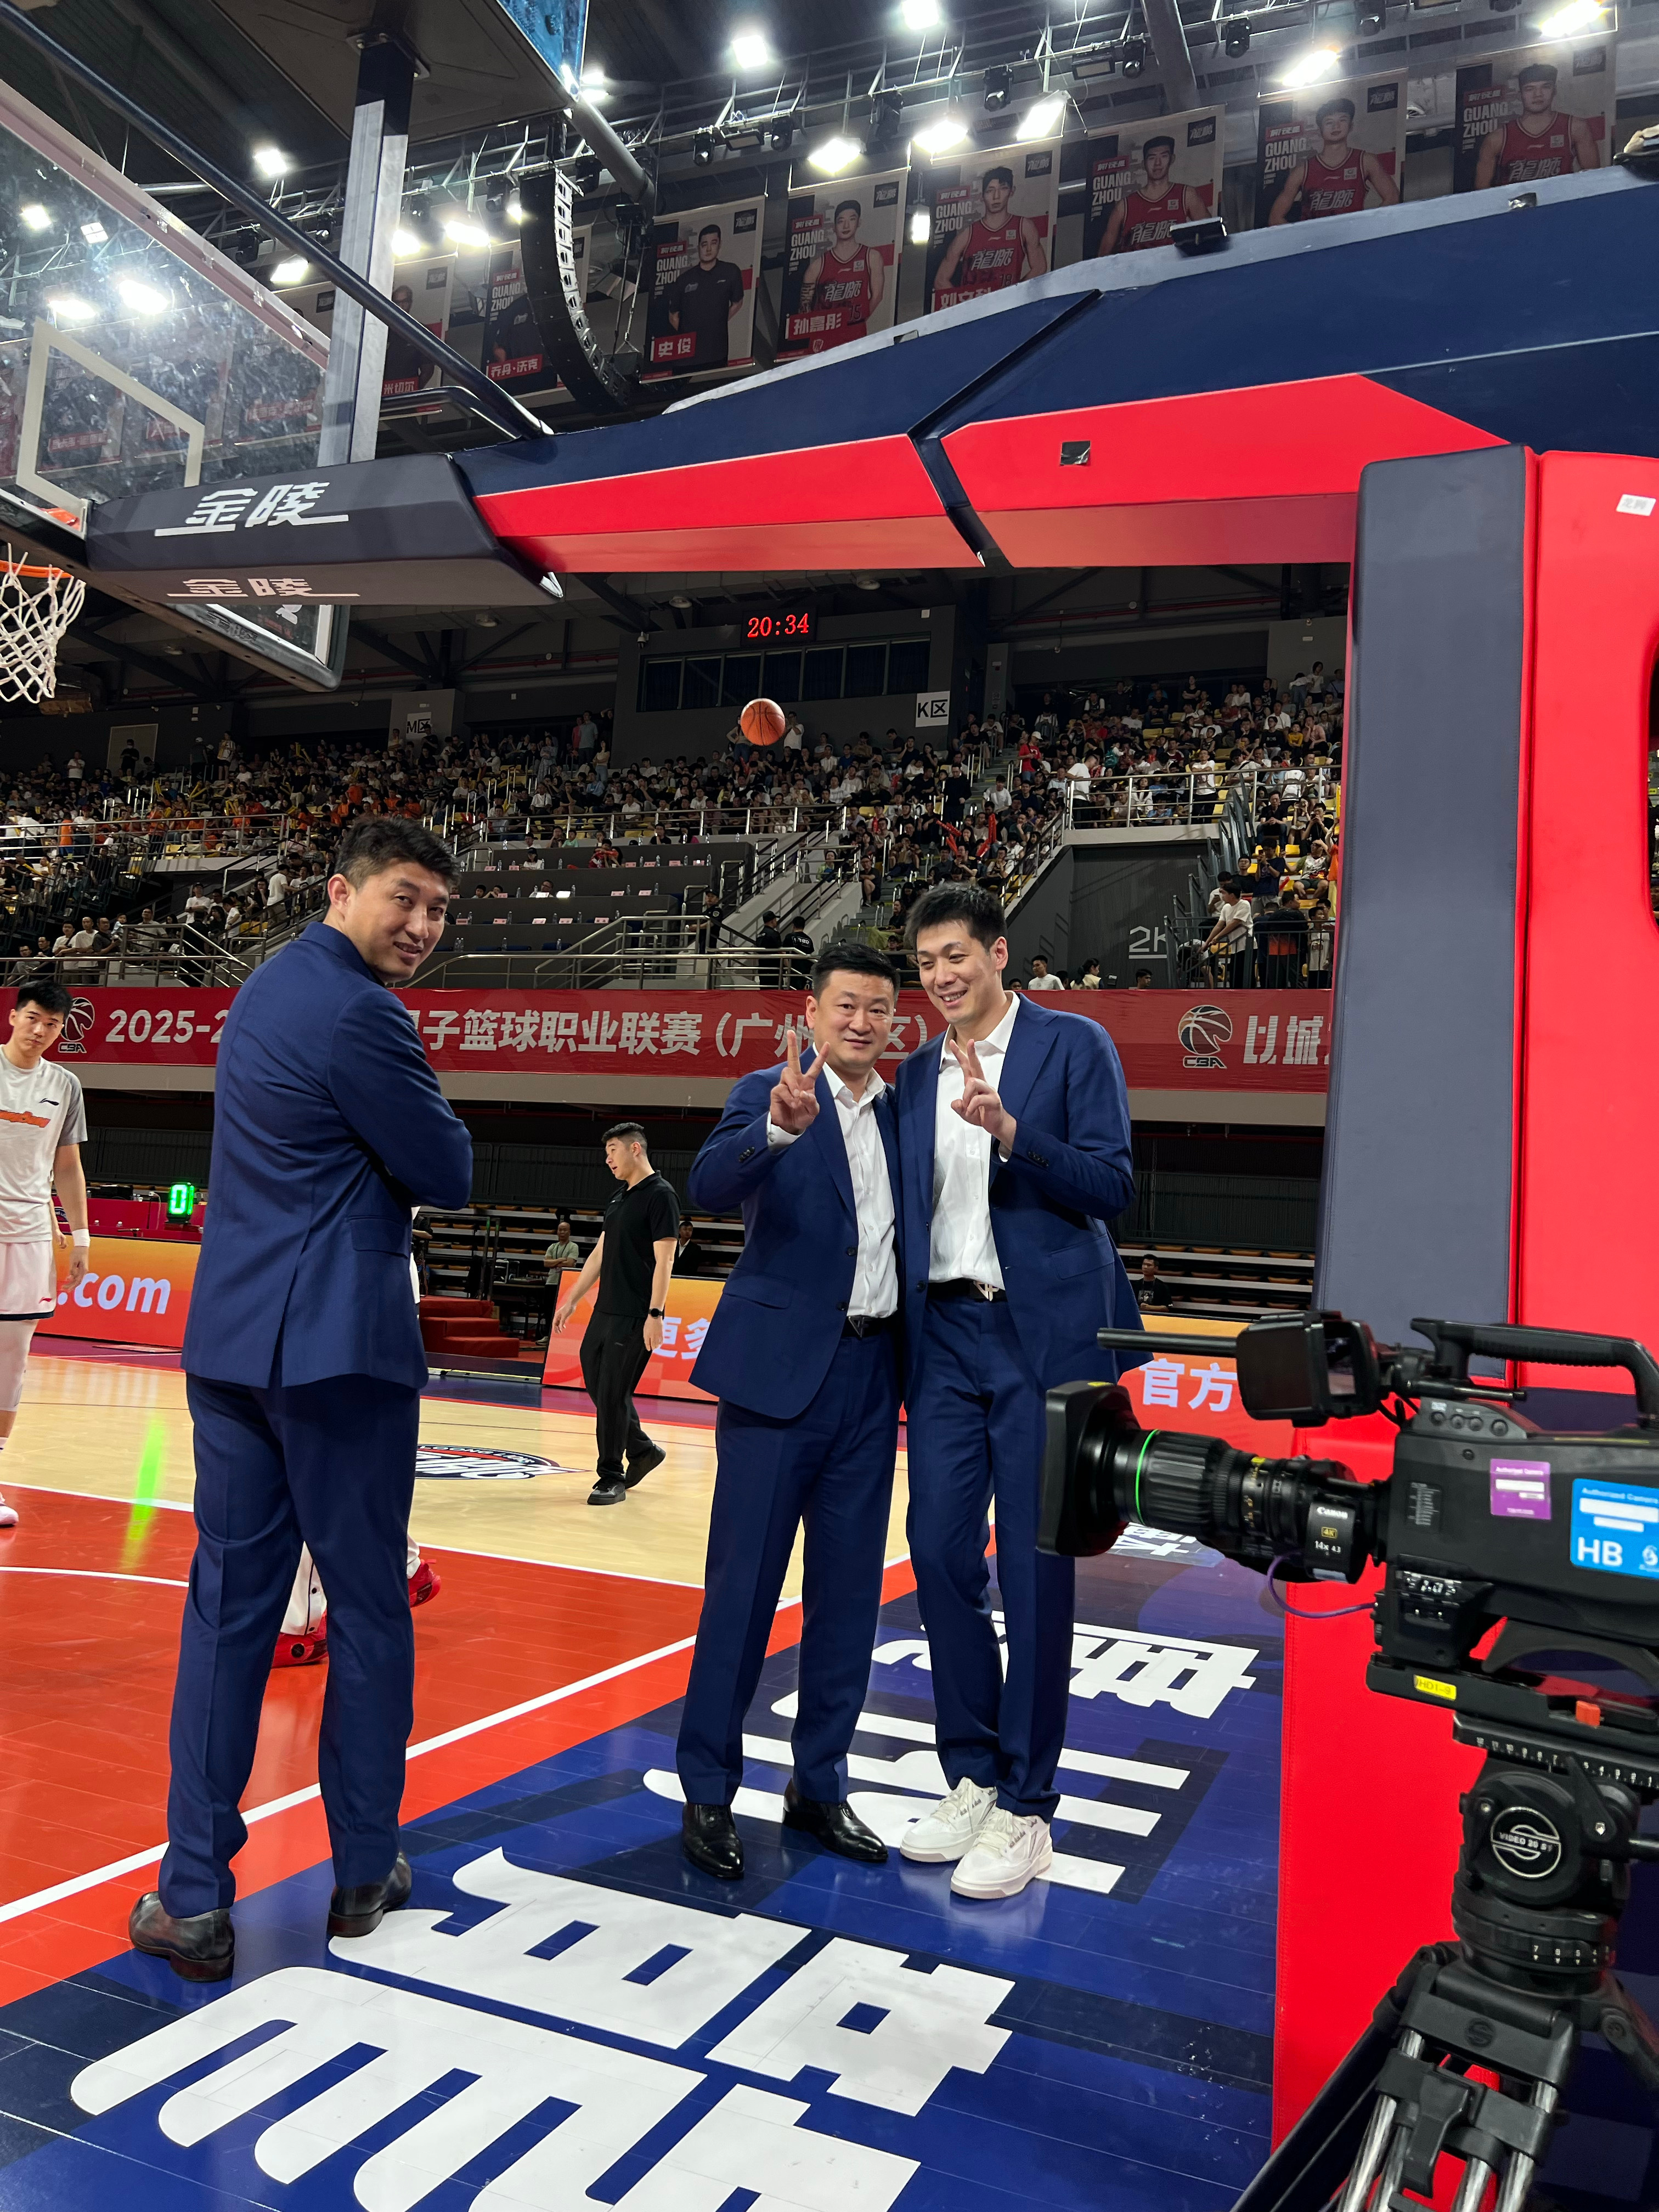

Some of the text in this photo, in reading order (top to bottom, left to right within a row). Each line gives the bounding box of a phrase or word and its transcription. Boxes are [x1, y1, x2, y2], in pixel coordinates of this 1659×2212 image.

[1464, 101, 1508, 122] GUANG
[1265, 138, 1306, 157] GUANG
[1265, 154, 1296, 173] ZHOU
[1093, 171, 1131, 191] GUANG
[1092, 187, 1122, 206] ZHOU
[935, 201, 972, 219] GUANG
[934, 217, 963, 234] ZHOU
[791, 230, 825, 247] GUANG
[790, 244, 817, 261] ZHOU
[657, 255, 688, 272] GUANG
[492, 283, 520, 298] GUANG
[793, 313, 842, 335] 孙嘉彤
[658, 337, 691, 357] 史俊
[491, 358, 538, 377] 乔丹·沃克
[154, 482, 348, 537] 金陵
[167, 578, 360, 597] 金陵
[747, 612, 809, 638] 20:34
[917, 699, 948, 718] K区
[407, 718, 431, 733] M区
[58, 1042, 86, 1053] CBA
[1243, 1015, 1329, 1065] 以城
[1183, 1056, 1227, 1069] CBA
[1139, 1358, 1238, 1412] 官方
[420, 1446, 494, 1454] LOONG
[1317, 1507, 1348, 1519] Canon
[1578, 1537, 1623, 1567] HB
[1499, 1832, 1526, 1844] VIDEO
